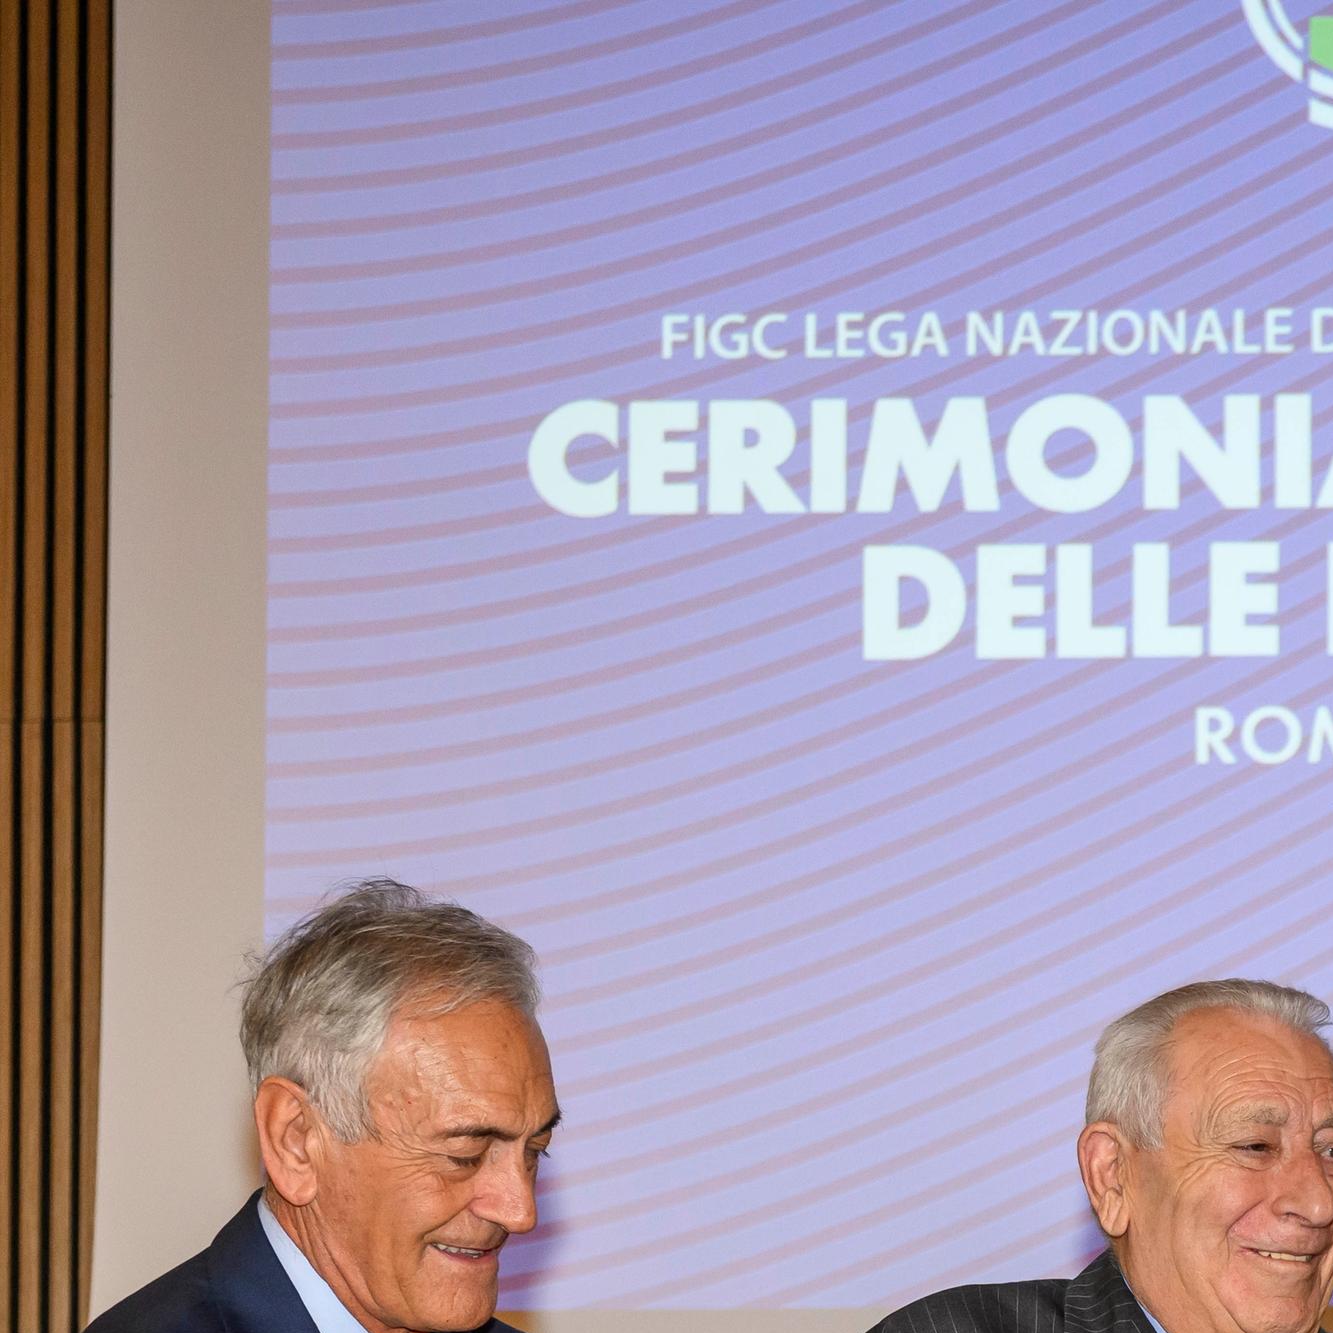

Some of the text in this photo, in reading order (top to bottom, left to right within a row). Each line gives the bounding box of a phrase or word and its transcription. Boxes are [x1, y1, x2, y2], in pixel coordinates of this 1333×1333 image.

[662, 314, 787, 359] FIGC
[805, 312, 949, 358] LEGA
[966, 308, 1293, 356] NAZIONALE
[862, 541, 1280, 661] DELLE
